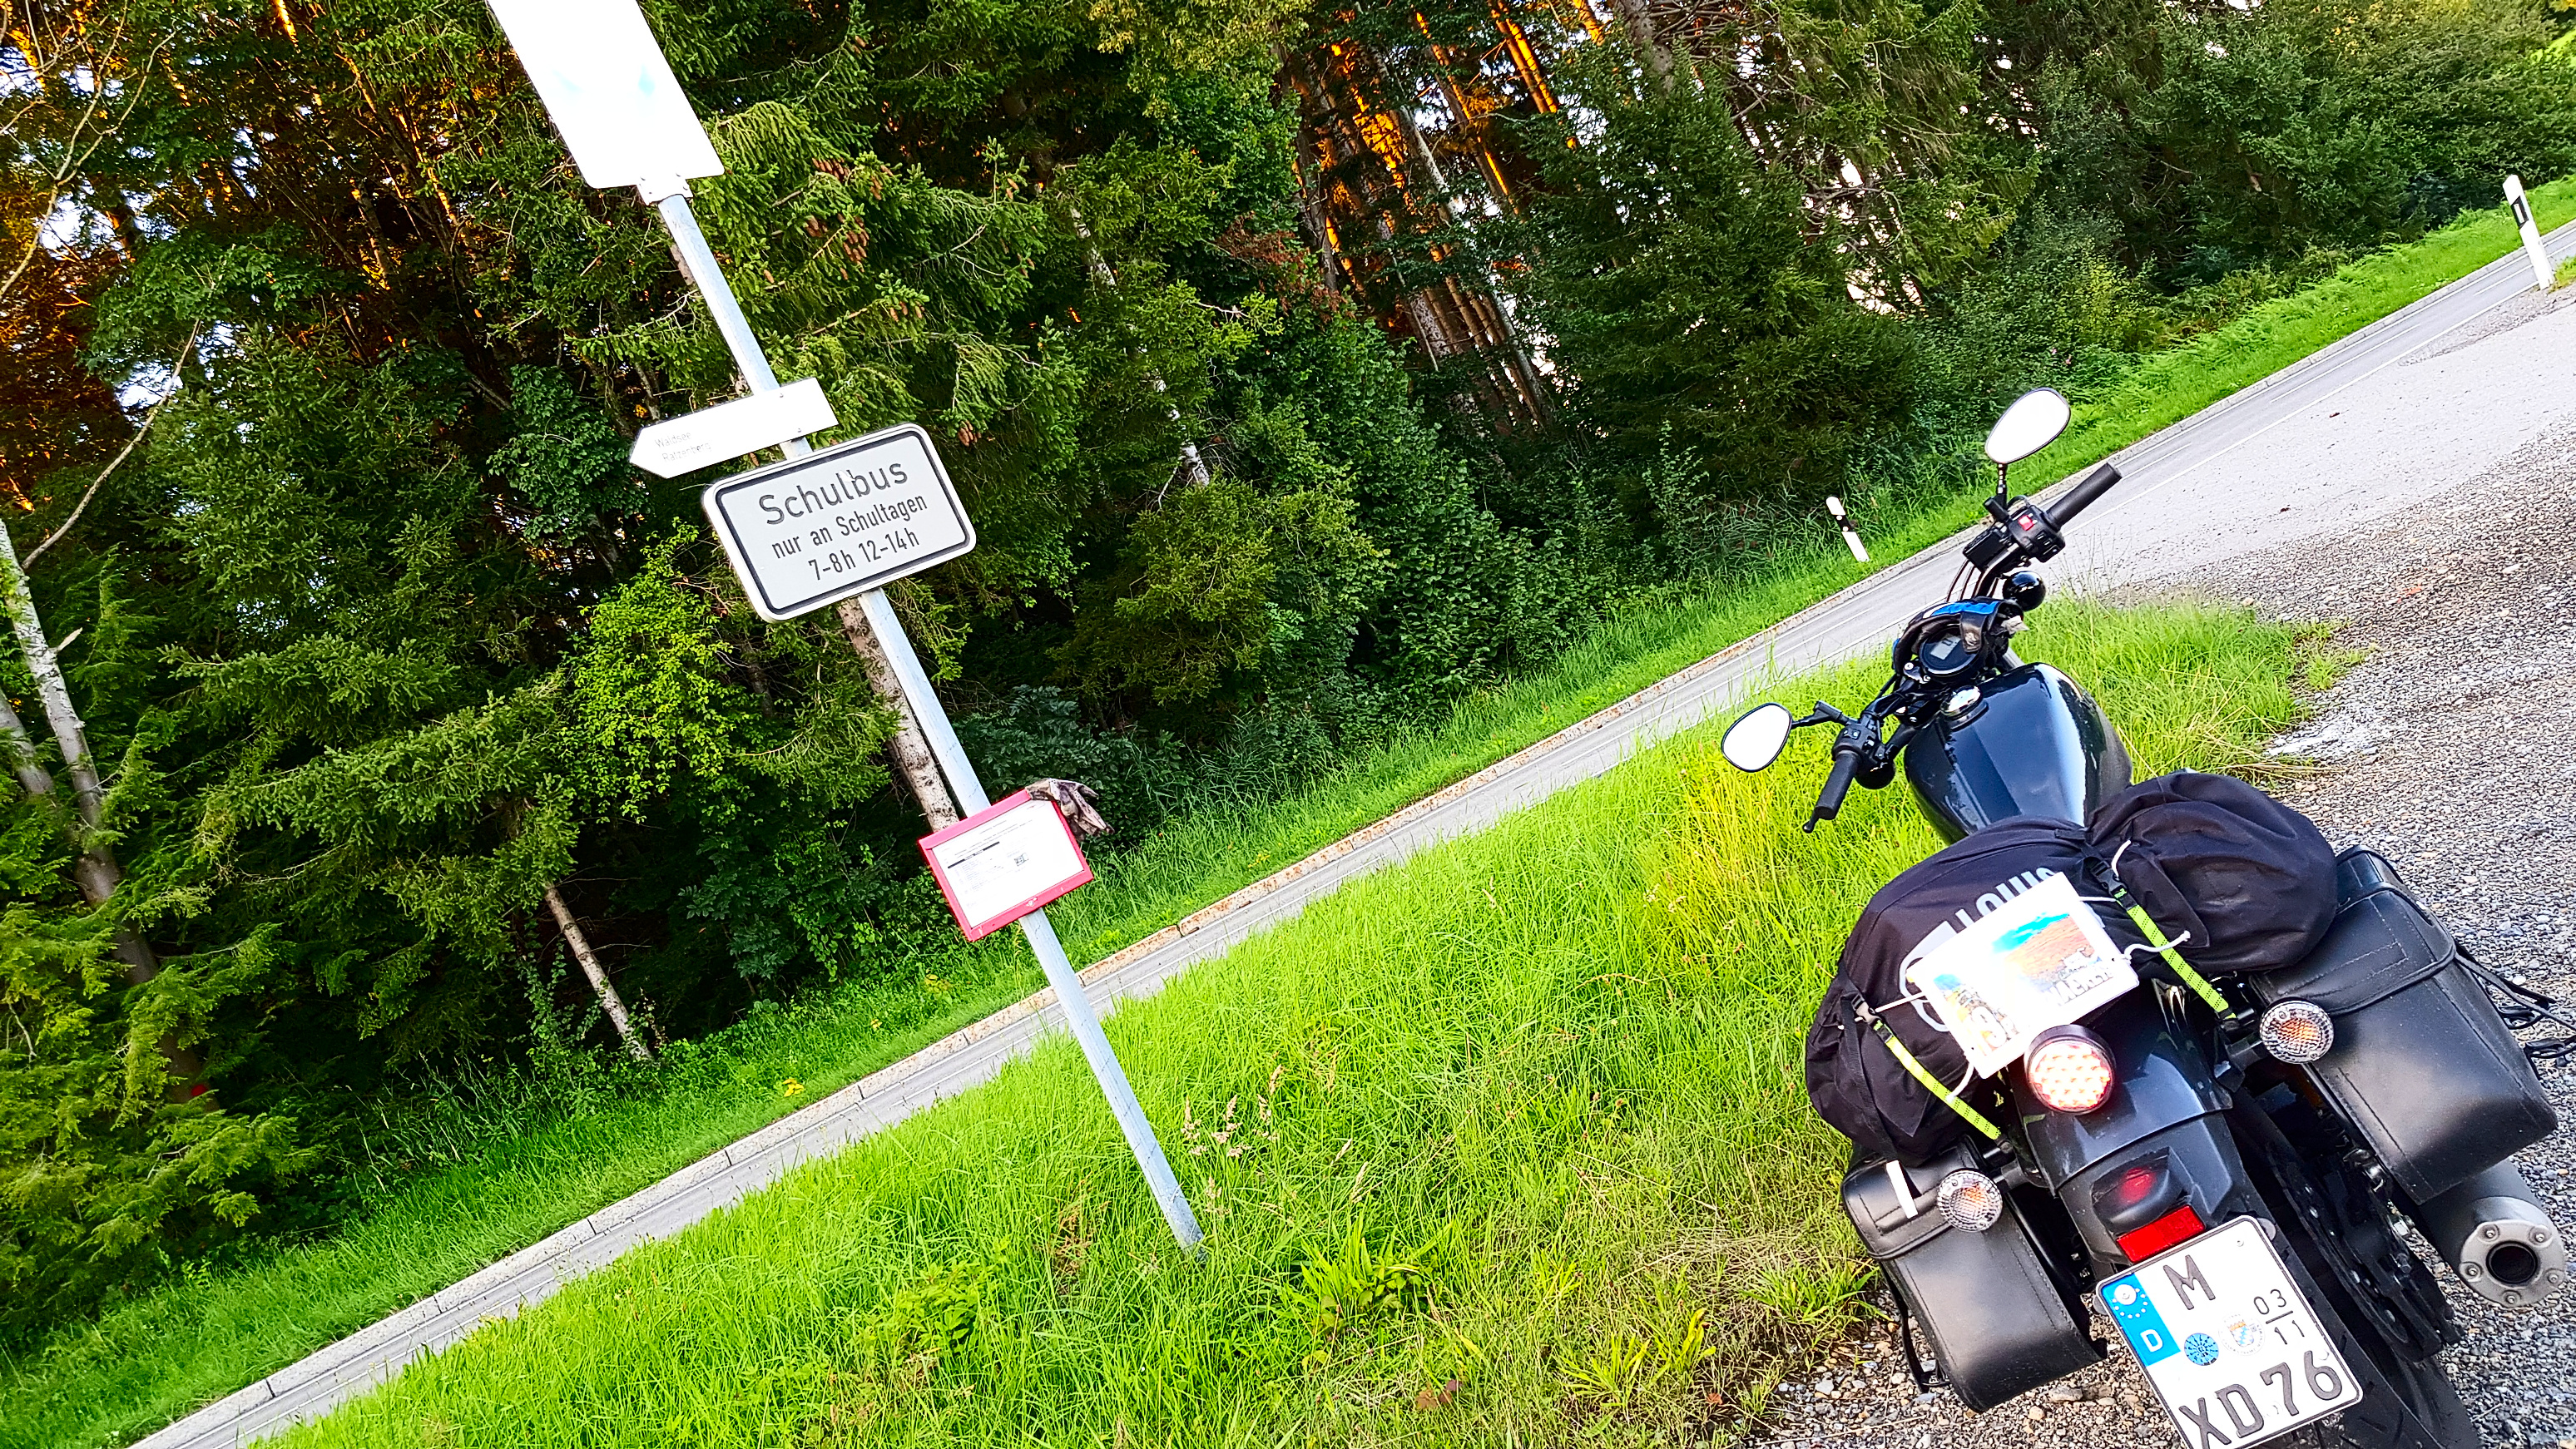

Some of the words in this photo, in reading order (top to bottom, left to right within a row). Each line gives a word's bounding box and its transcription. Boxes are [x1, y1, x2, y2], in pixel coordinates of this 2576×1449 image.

[654, 430, 692, 448] Waldsee
[759, 462, 908, 524] Schulbus
[771, 537, 802, 559] nur
[810, 525, 833, 546] an
[835, 493, 929, 536] Schultagen
[2163, 1254, 2216, 1310] M
[2253, 1288, 2287, 1315] 03
[2140, 1329, 2163, 1353] D
[2274, 1320, 2305, 1345] 11
